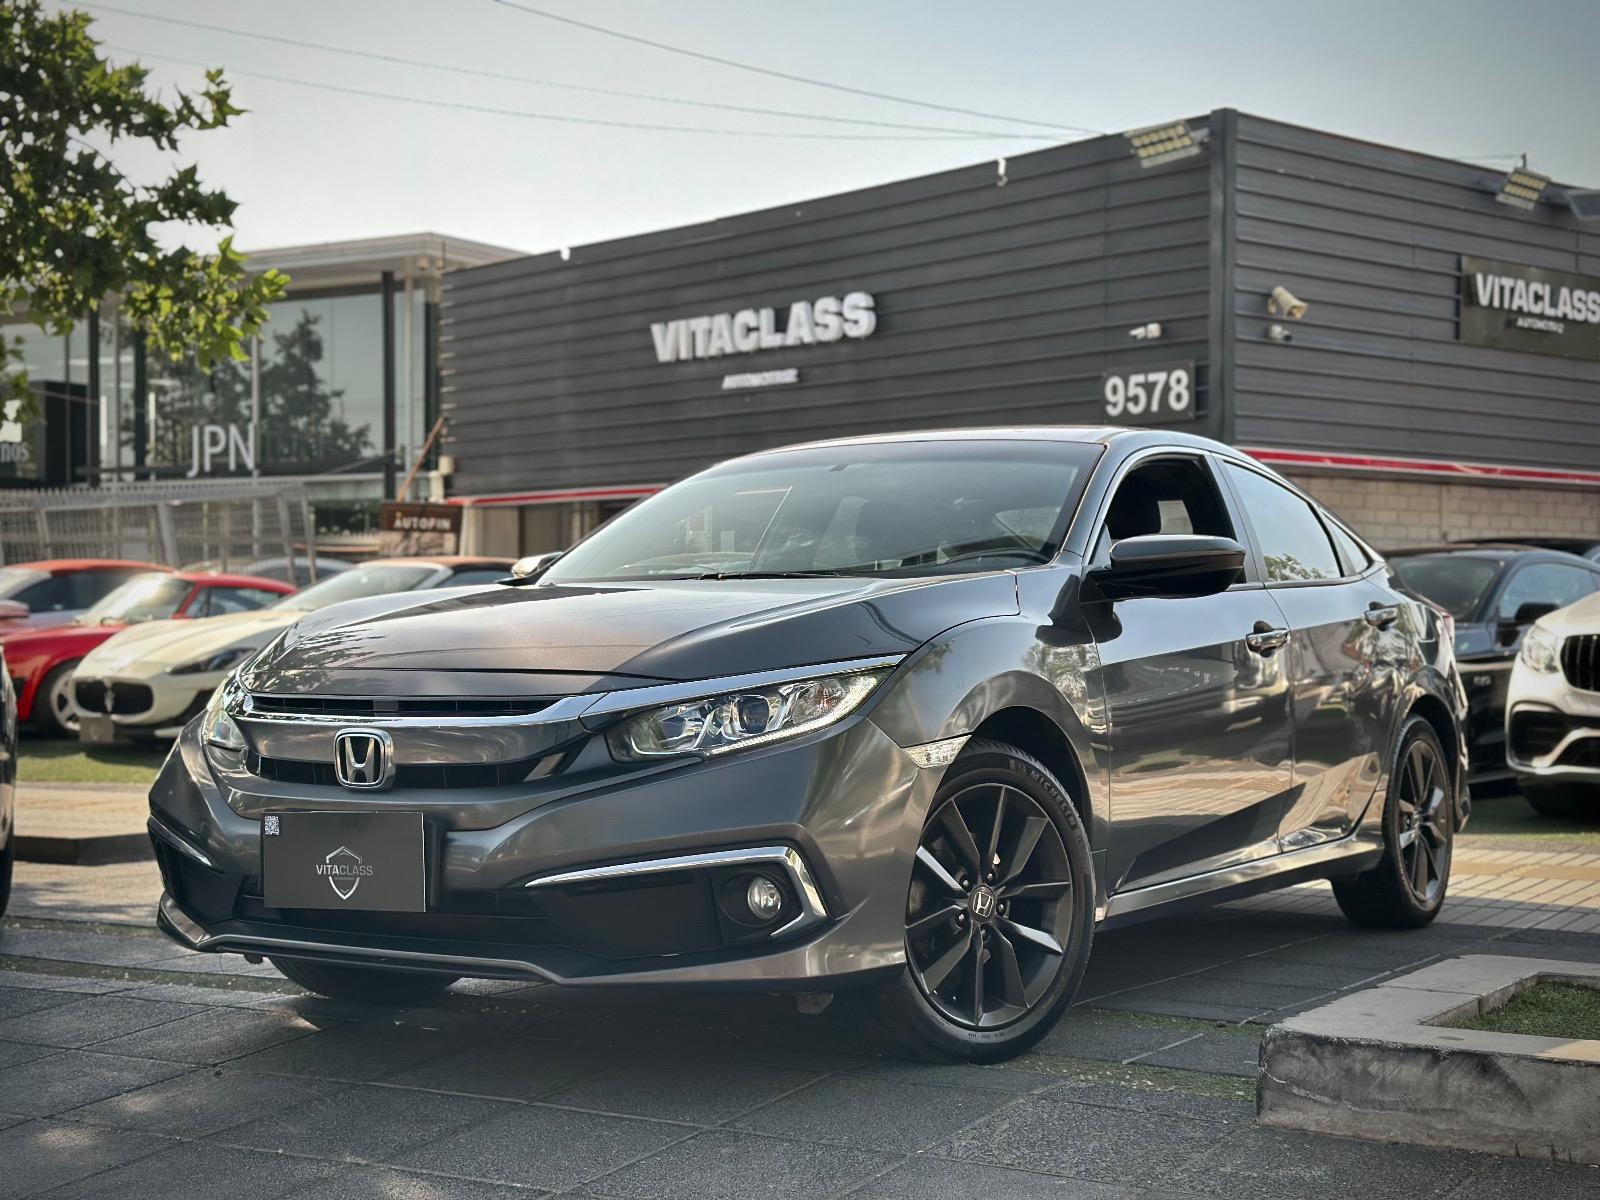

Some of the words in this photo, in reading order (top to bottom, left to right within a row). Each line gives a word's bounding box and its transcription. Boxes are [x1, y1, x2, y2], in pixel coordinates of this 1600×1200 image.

[1476, 272, 1600, 324] VITACLASS
[651, 291, 877, 363] VITACLASS
[1104, 369, 1190, 417] 9578
[186, 424, 257, 478] JPN
[315, 864, 374, 876] VITACLASS
